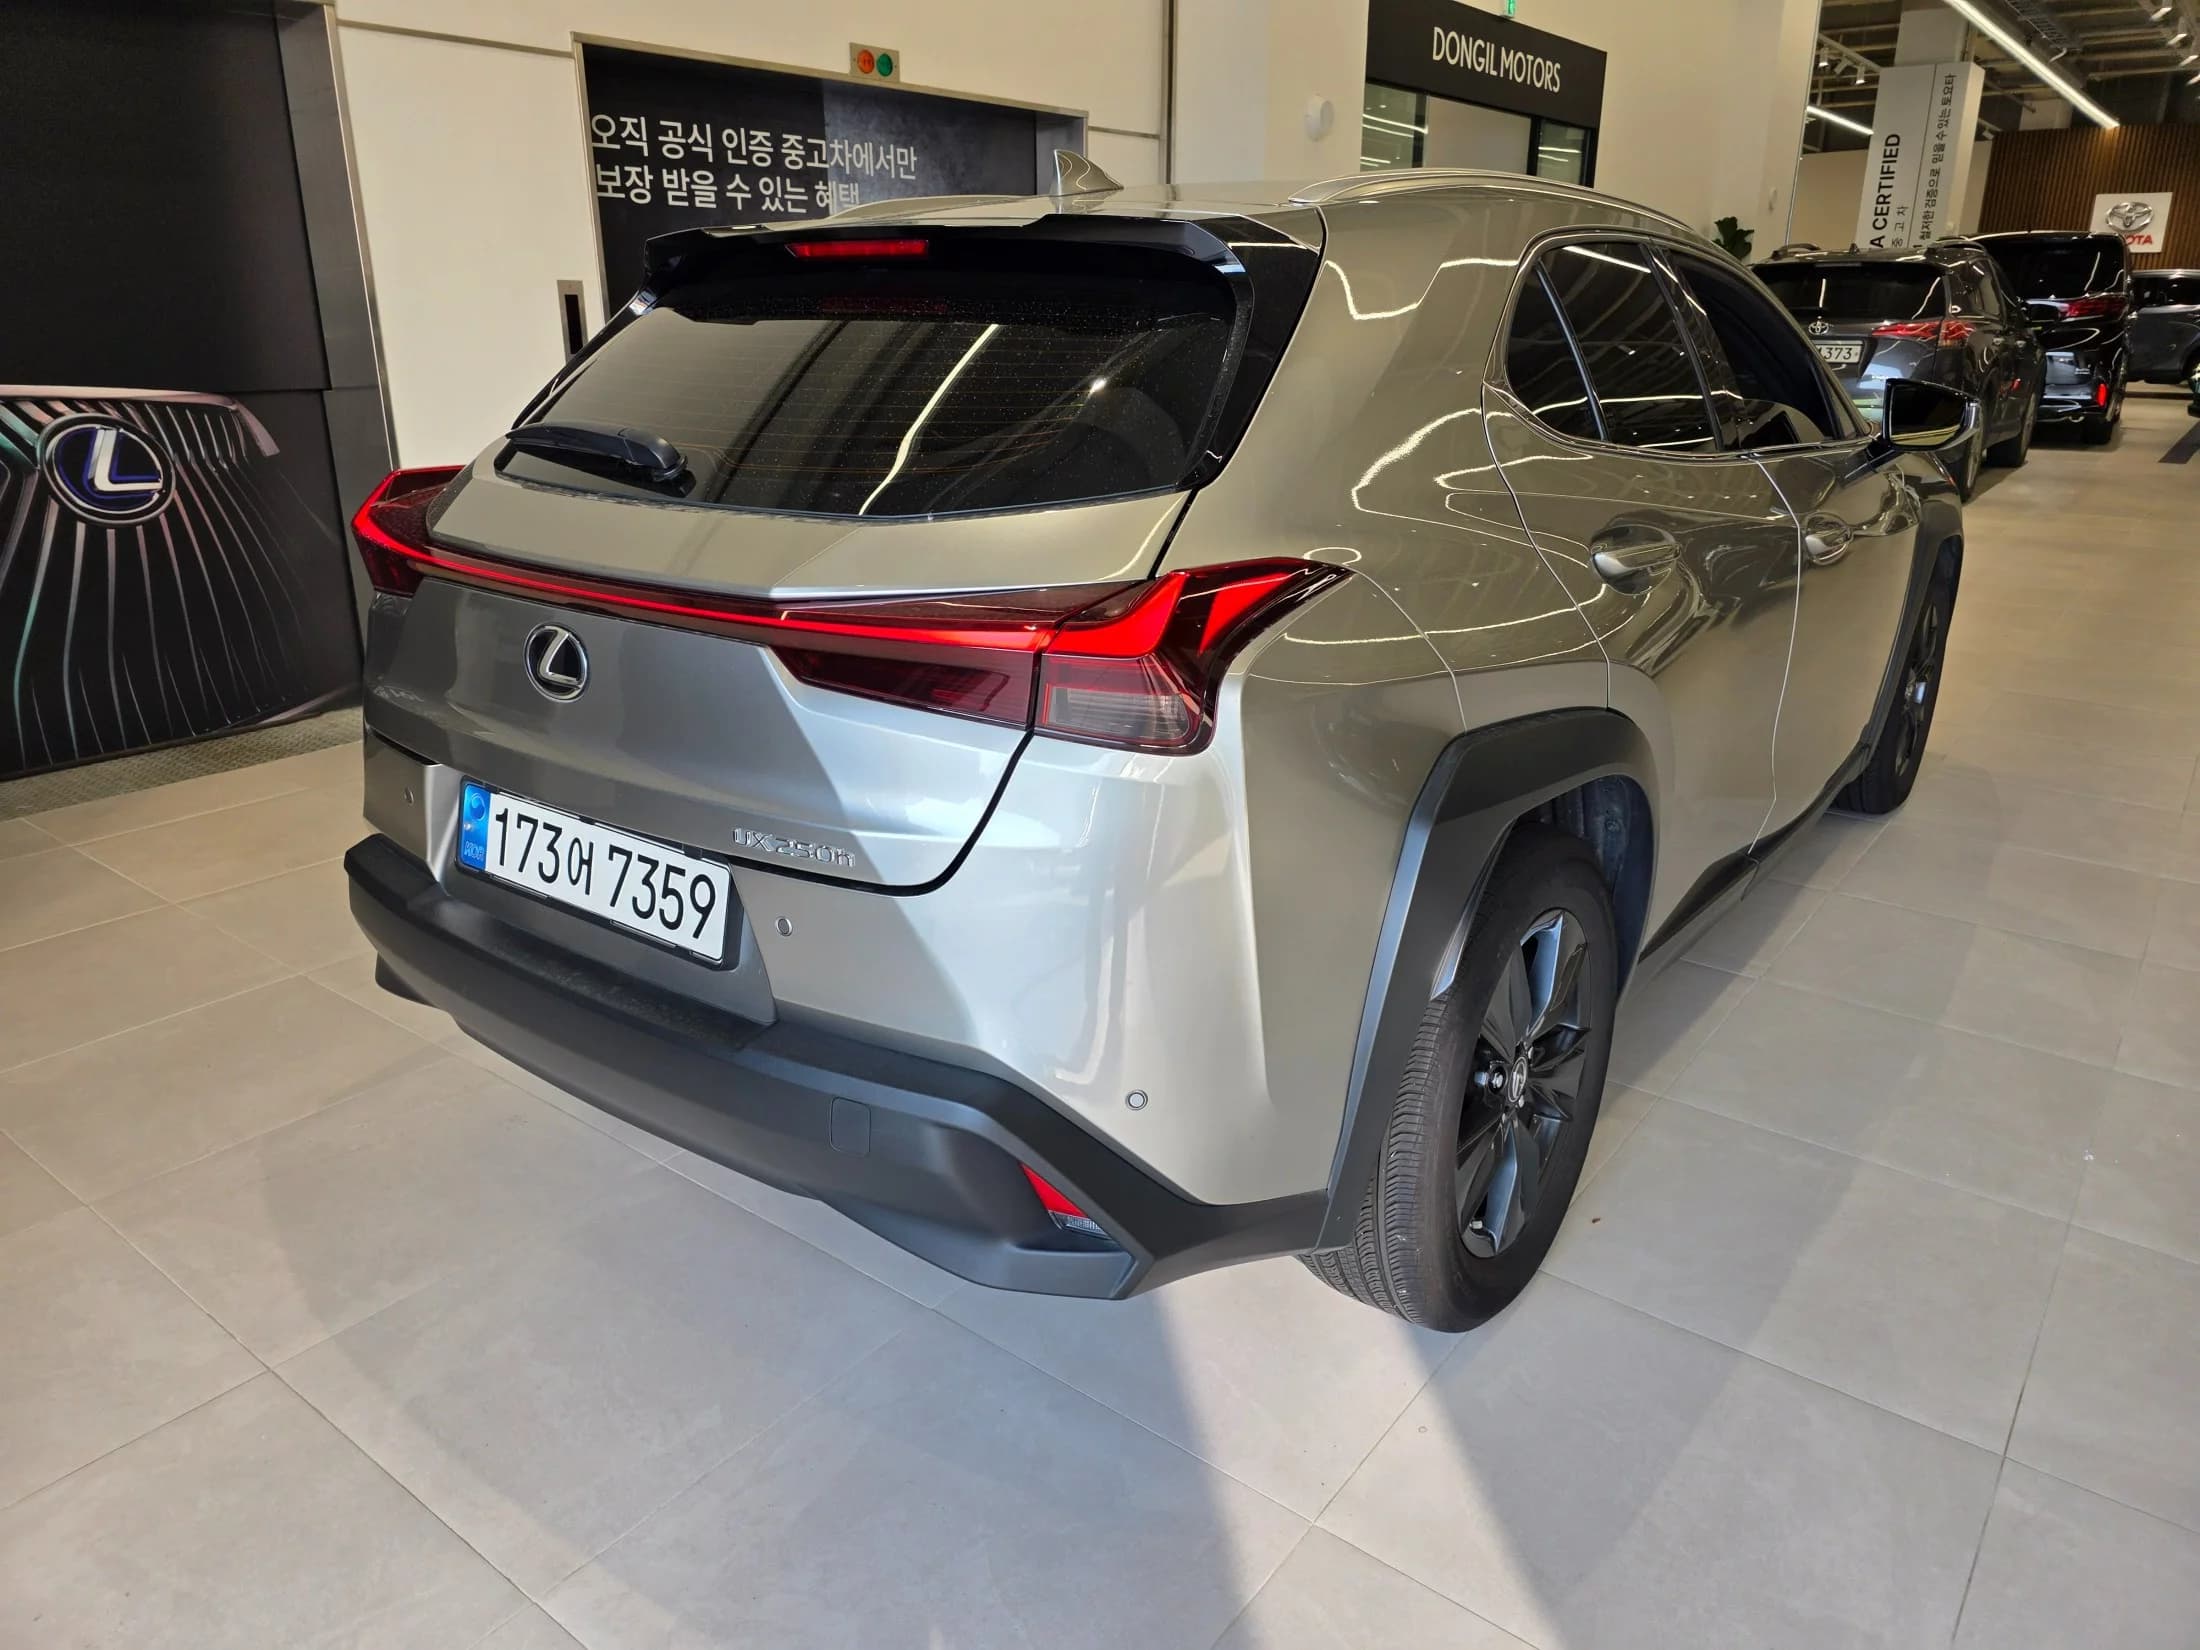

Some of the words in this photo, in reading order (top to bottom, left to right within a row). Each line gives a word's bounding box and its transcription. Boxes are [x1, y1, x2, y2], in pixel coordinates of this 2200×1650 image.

[1433, 26, 1497, 76] DONGIL
[1500, 46, 1561, 93] MOTORS
[591, 113, 649, 156] 오직
[658, 119, 713, 162] 공식
[722, 126, 774, 167] 인증
[781, 133, 918, 180] 중고차에서만
[596, 164, 653, 205] 보장
[662, 168, 718, 209] 받을
[726, 173, 752, 210] 수
[759, 175, 808, 214] 있는
[814, 179, 860, 217] 혜택
[1872, 133, 1901, 231] CERTIFIED
[2125, 234, 2153, 246] OTA
[1819, 346, 1853, 360] 373
[732, 826, 775, 852] UX
[495, 807, 594, 896] 173어
[608, 843, 717, 940] 7359
